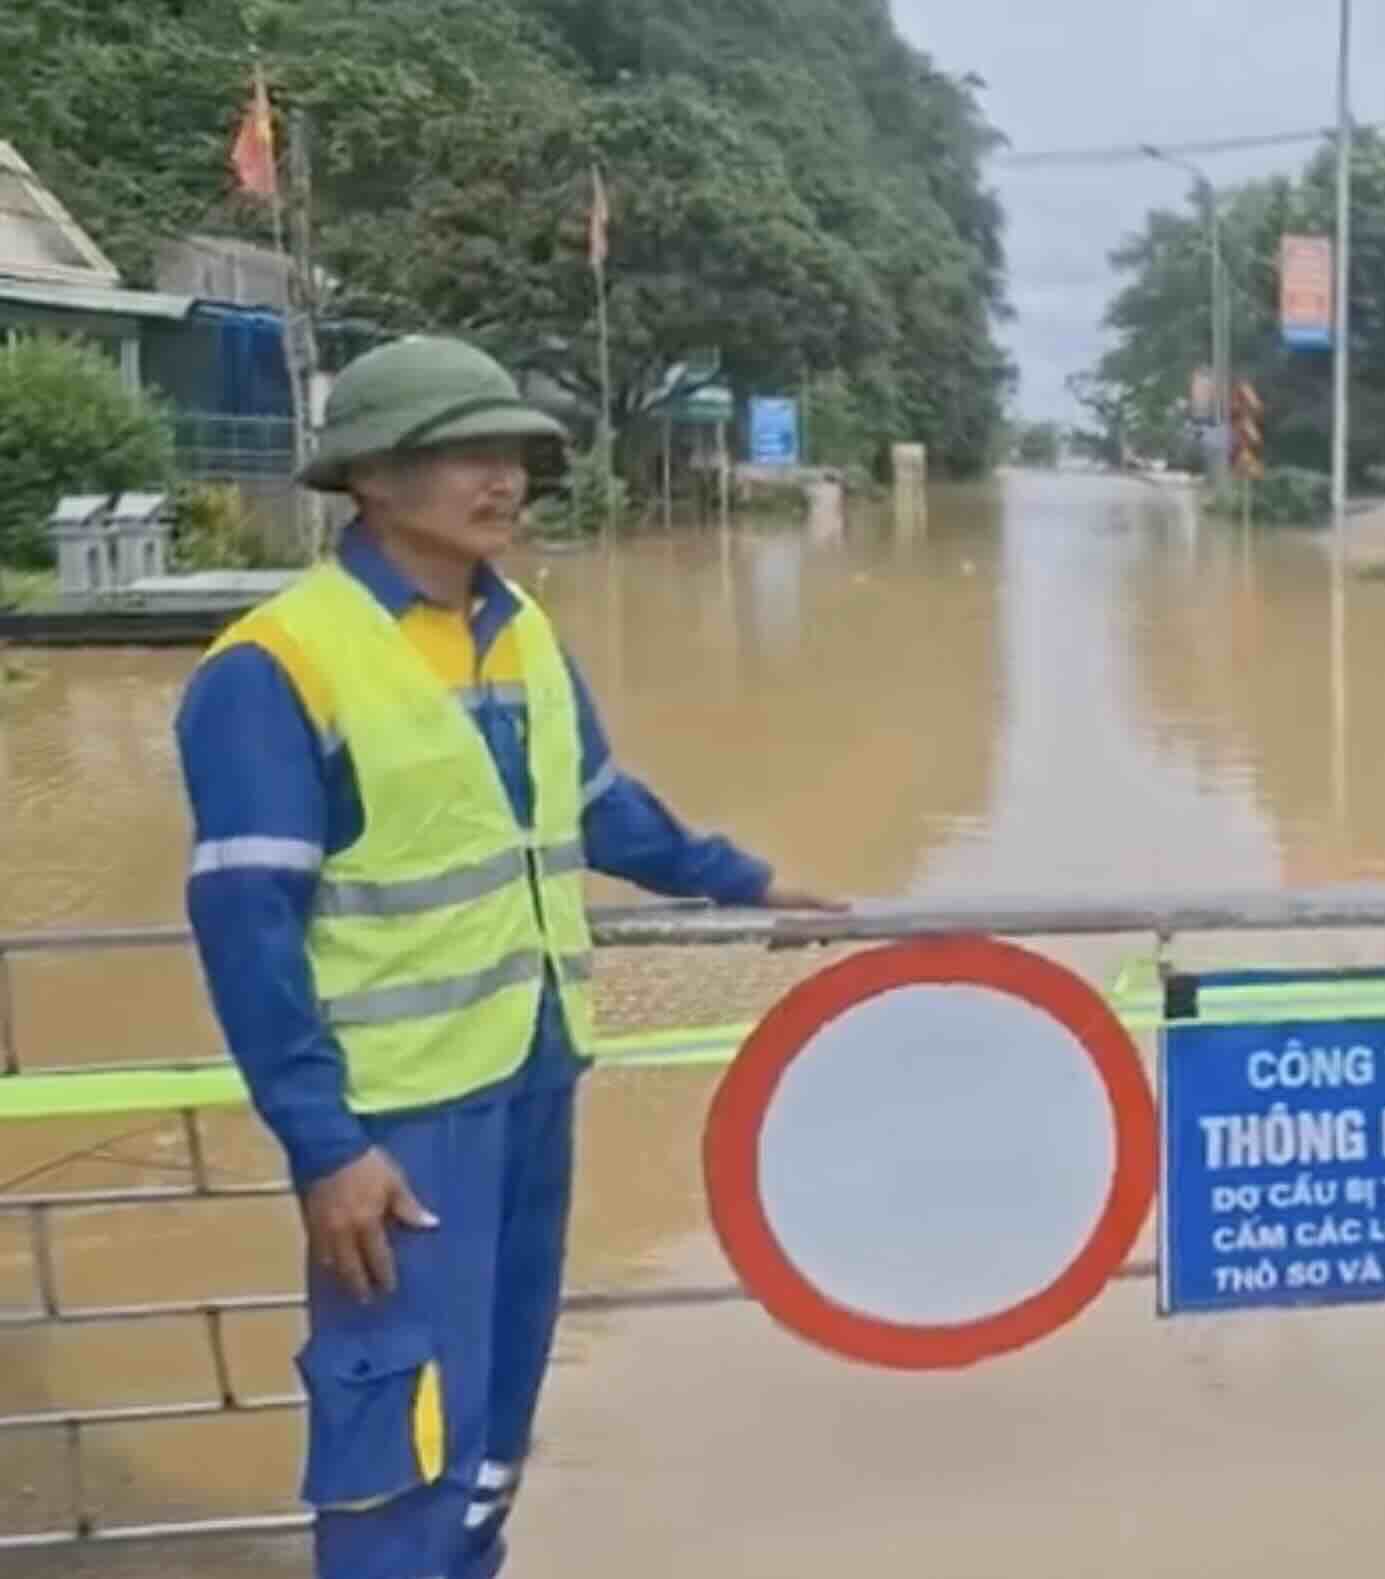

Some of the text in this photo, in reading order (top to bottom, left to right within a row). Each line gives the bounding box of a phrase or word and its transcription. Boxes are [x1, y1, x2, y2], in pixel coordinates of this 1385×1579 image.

[1248, 1038, 1374, 1089] CÔNG
[1198, 1101, 1367, 1170] THÔNG
[1212, 1214, 1287, 1251] CẤM
[1294, 1216, 1362, 1246] CÁC
